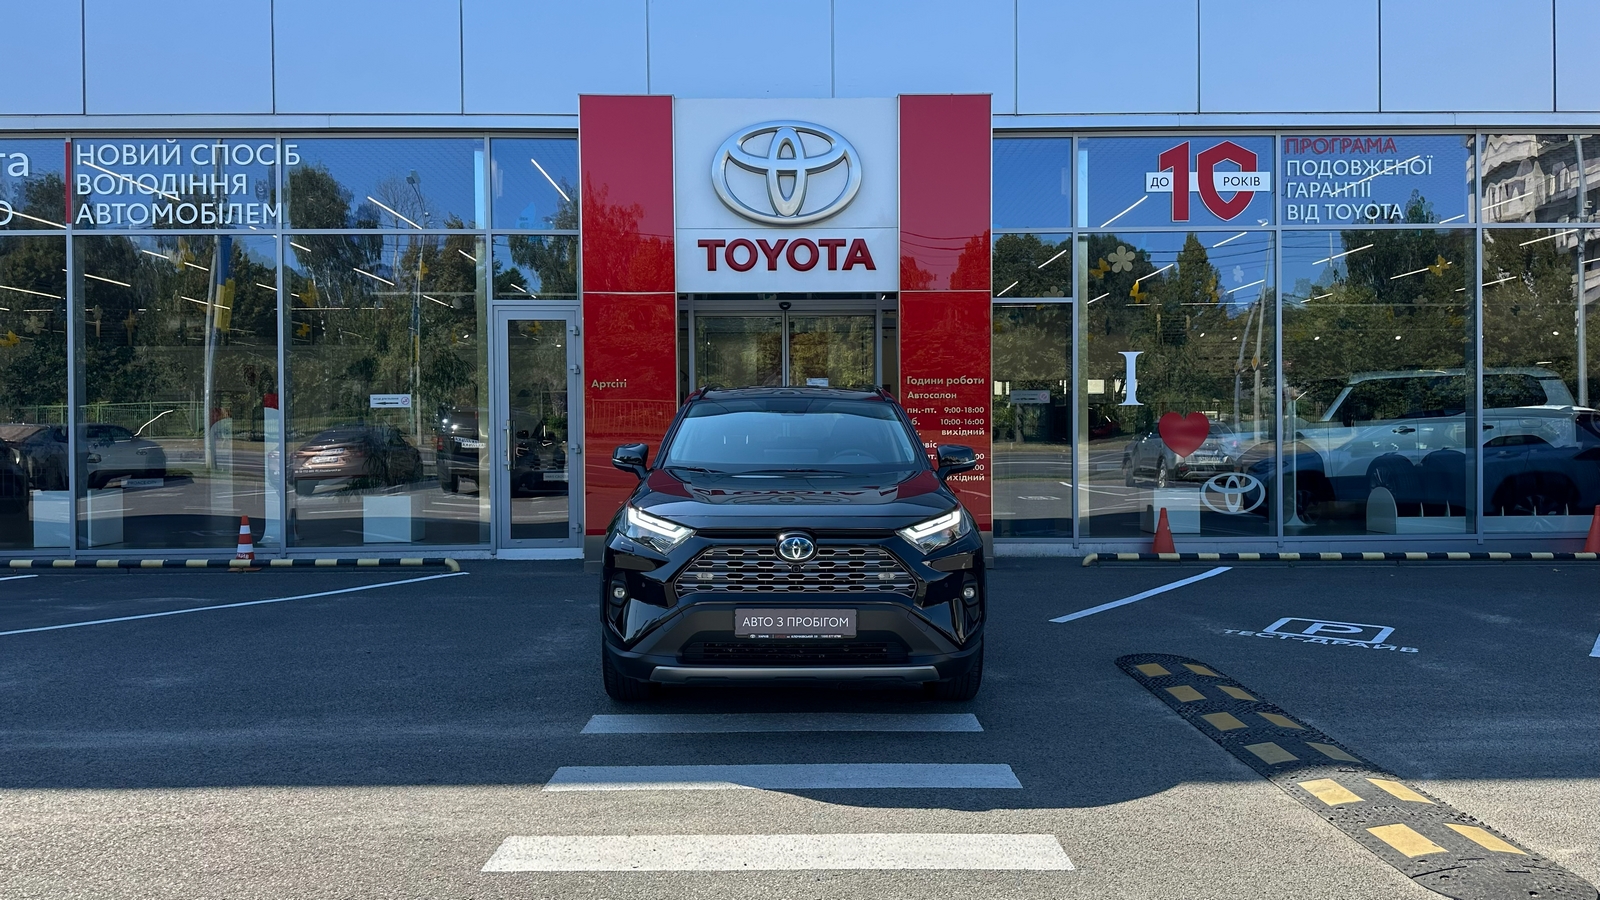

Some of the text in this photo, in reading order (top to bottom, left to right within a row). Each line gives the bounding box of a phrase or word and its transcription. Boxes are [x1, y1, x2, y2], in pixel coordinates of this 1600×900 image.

[77, 139, 300, 166] НОВИЙ СПОСІБ
[1285, 137, 1398, 154] ПРОГРАМА
[1287, 155, 1434, 179] ПОДОВЖЕНОЇ
[77, 173, 247, 199] ВОЛОДІННЯ
[1150, 177, 1169, 189] ДО
[1223, 176, 1261, 187] РОКІВ
[1287, 178, 1373, 198] ГАРАНТІЇ
[75, 203, 282, 225] АВТОМОБІЛЕМ
[1287, 203, 1404, 224] ВІД TOYOTA
[698, 238, 877, 272] TOYOTA
[591, 378, 627, 391] Артсіті
[906, 375, 984, 387] Години роботи
[907, 391, 957, 399] Автосалон
[941, 427, 985, 436] вихідний
[946, 473, 985, 483] ихідний
[742, 616, 774, 627] АВТО
[787, 617, 849, 627] ПРОБІГОМ
[1302, 622, 1363, 635] P
[1223, 628, 1419, 653] ТЕСТ-ДРАЙВ
